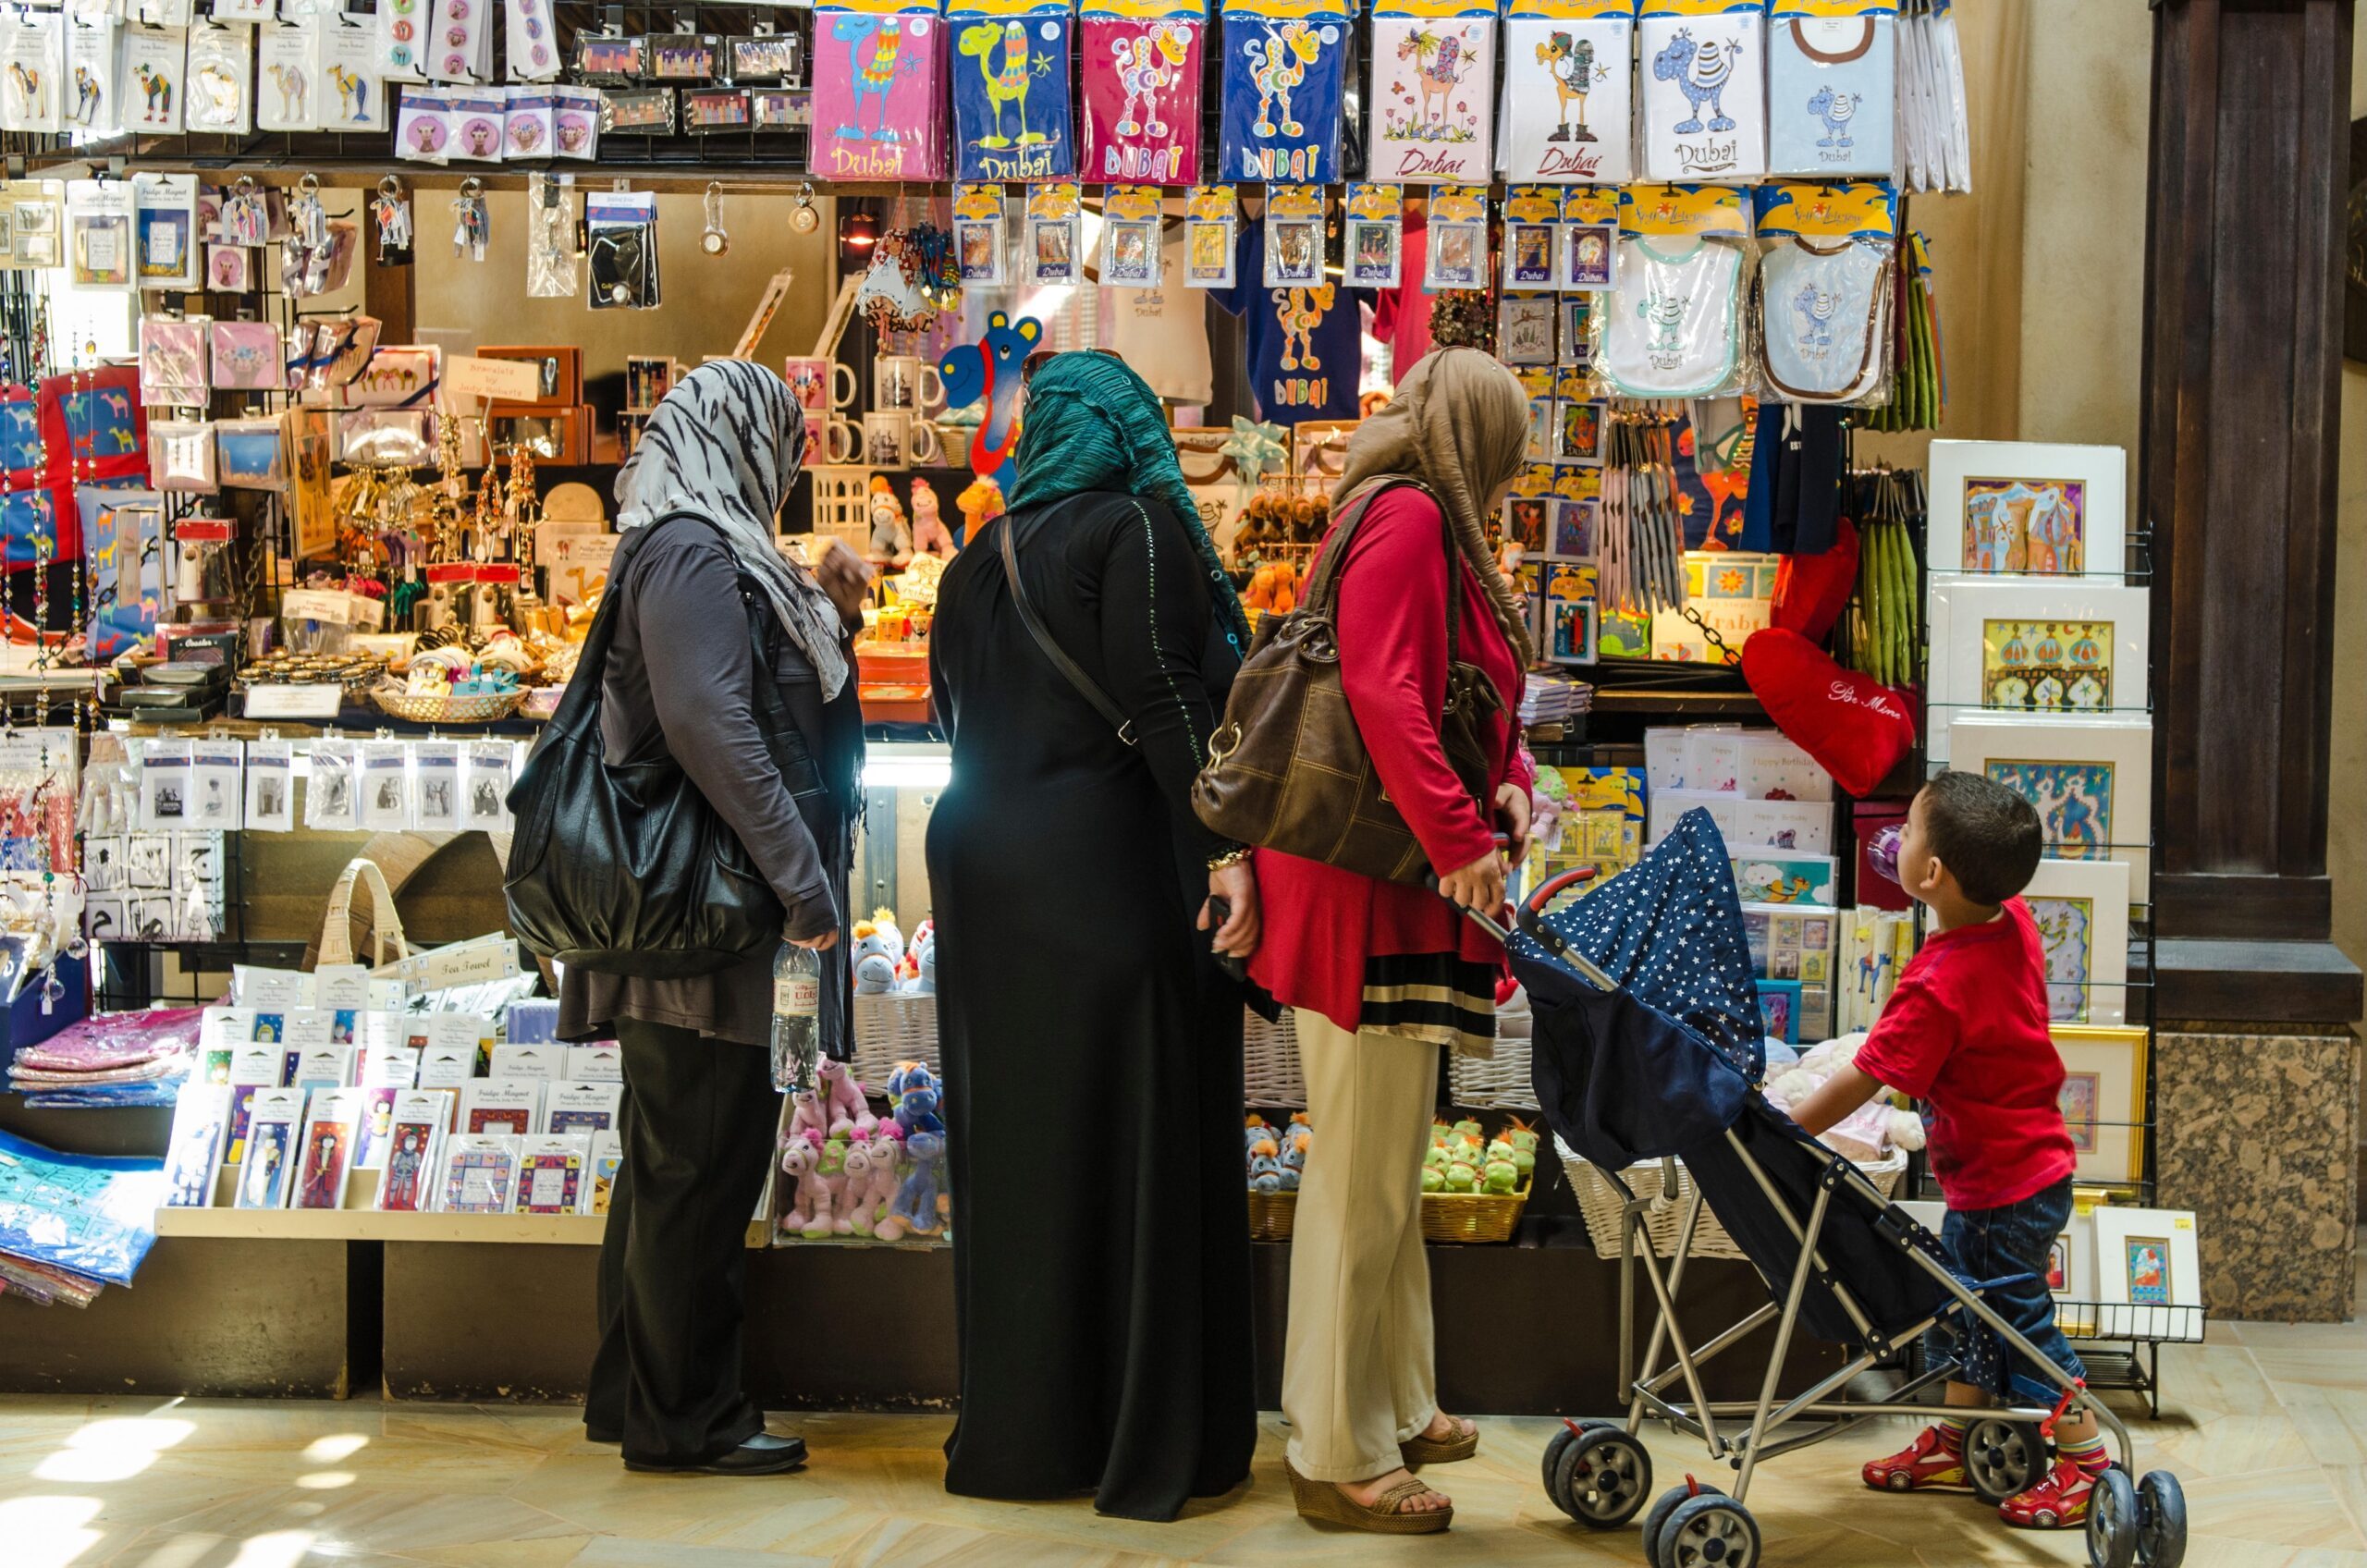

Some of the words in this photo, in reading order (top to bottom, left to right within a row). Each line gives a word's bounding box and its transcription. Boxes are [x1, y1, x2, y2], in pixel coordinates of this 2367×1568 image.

[1537, 146, 1602, 174] Dubai
[1674, 138, 1738, 165] Dubai
[1819, 149, 1851, 163] Dubai
[830, 146, 904, 178] Dubai
[979, 150, 1054, 179] Dubai
[1104, 145, 1183, 182] DUBAI
[1242, 144, 1319, 182] DUBAI
[1395, 148, 1466, 176] Dubai
[966, 266, 988, 278] Dubai
[1043, 266, 1066, 277] Dubai
[1116, 266, 1142, 278] Dubai
[1361, 266, 1386, 278] Dubai
[1520, 270, 1545, 281] Dubai
[1577, 272, 1603, 282] Dubai
[1134, 307, 1162, 317] Dubai
[1274, 377, 1328, 410] DUBAI
[1828, 680, 1858, 704] Be
[1861, 696, 1901, 719] Mine
[1753, 756, 1780, 767] Happy
[1782, 756, 1815, 767] Birthday
[441, 963, 460, 976] Tea
[463, 958, 491, 972] Towel
